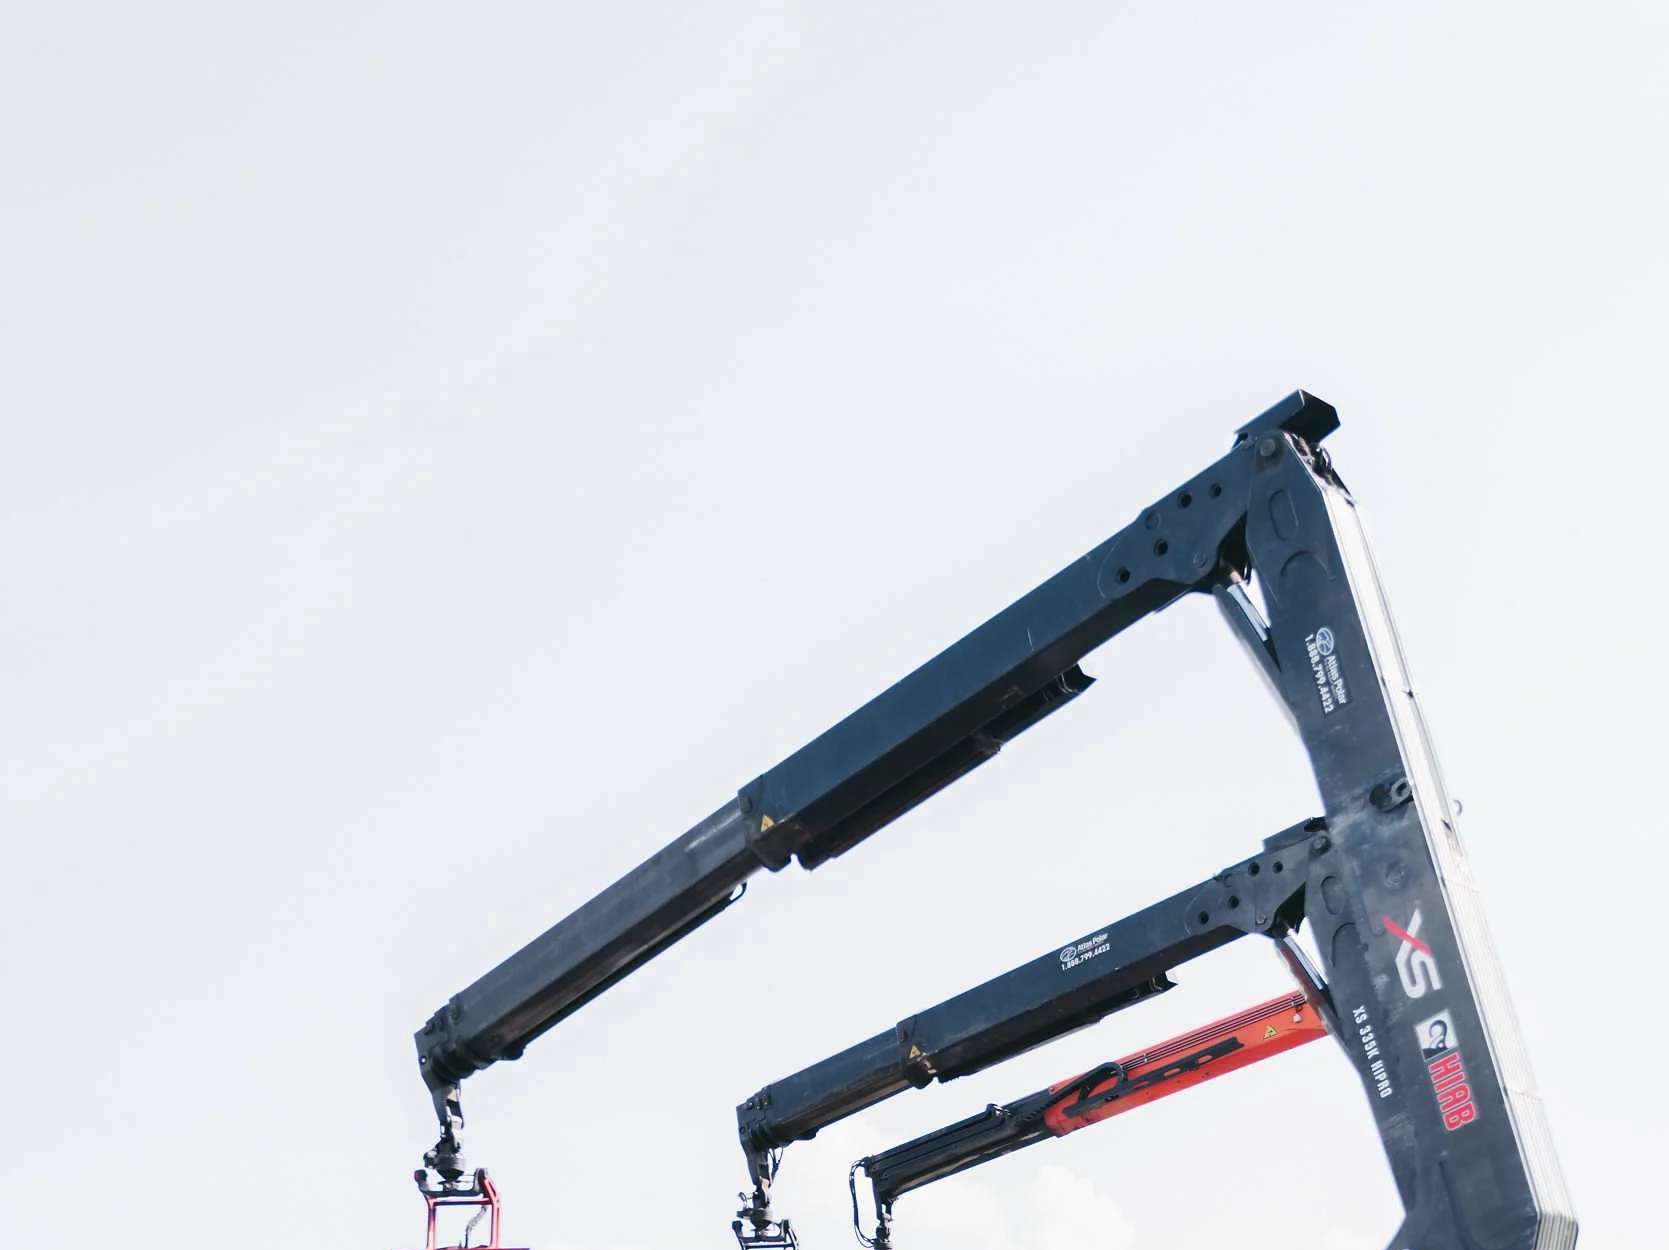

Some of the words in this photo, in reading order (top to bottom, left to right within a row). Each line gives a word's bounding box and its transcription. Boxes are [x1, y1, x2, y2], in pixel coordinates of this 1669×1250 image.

[1305, 633, 1334, 714] 1.888.799.4422
[1326, 655, 1339, 680] Atlas
[1334, 679, 1347, 704] Polar
[1352, 1005, 1368, 1025] XS
[1359, 1023, 1380, 1060] 335K
[1370, 1059, 1393, 1099] HIPRO
[1428, 1051, 1478, 1132] HIAB
